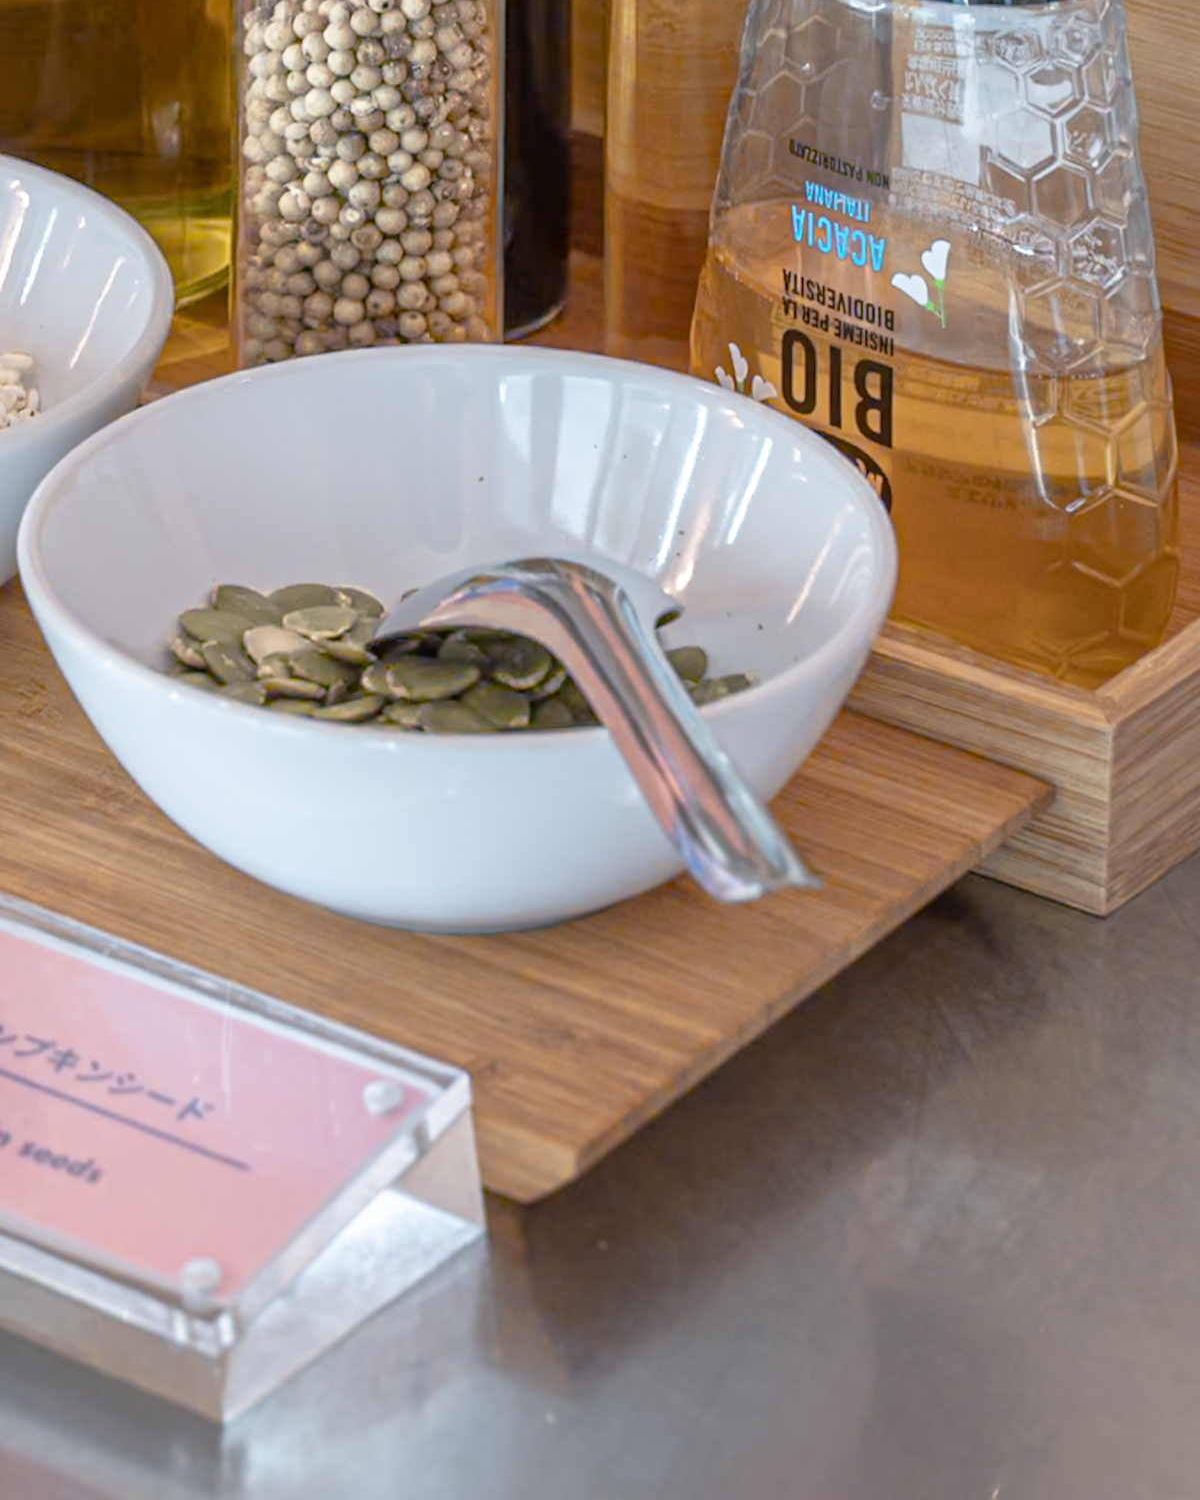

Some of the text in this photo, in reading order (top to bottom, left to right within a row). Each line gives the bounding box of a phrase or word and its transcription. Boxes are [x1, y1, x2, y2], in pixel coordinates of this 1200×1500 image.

[788, 138, 891, 190] NON PASTORIZZATO
[804, 180, 871, 223] ITALIANA
[790, 204, 887, 272] ACACIA
[782, 268, 895, 332] BIODIVERSITÀ
[782, 295, 895, 357] INSIEME PER LA
[781, 328, 894, 449] BIO
[17, 1140, 105, 1185] seeds
